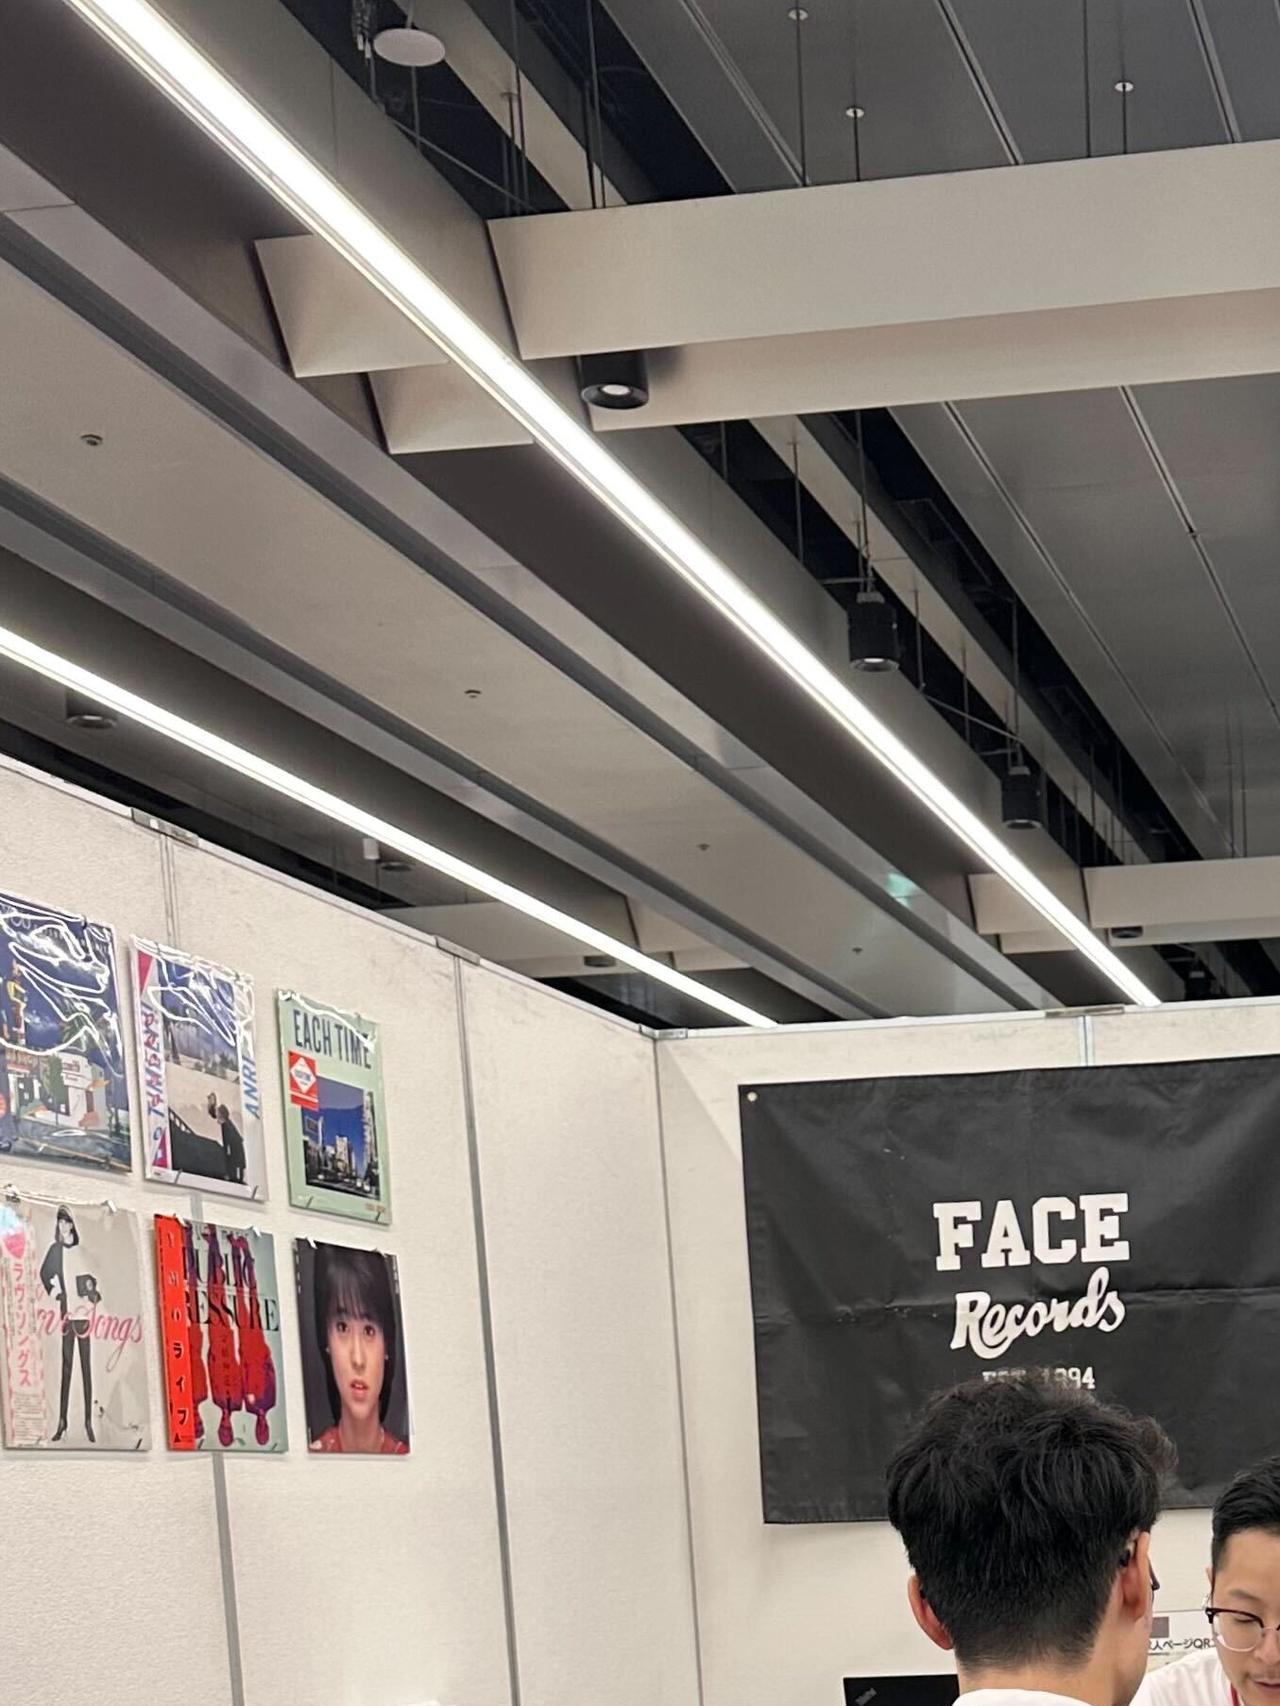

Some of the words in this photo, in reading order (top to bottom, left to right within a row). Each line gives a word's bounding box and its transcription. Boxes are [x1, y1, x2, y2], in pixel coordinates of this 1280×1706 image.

[293, 1009, 333, 1057] EACH
[334, 1023, 372, 1069] TIME
[242, 1055, 261, 1120] ANRI
[933, 1193, 1130, 1271] FACE
[950, 1266, 1126, 1359] Records
